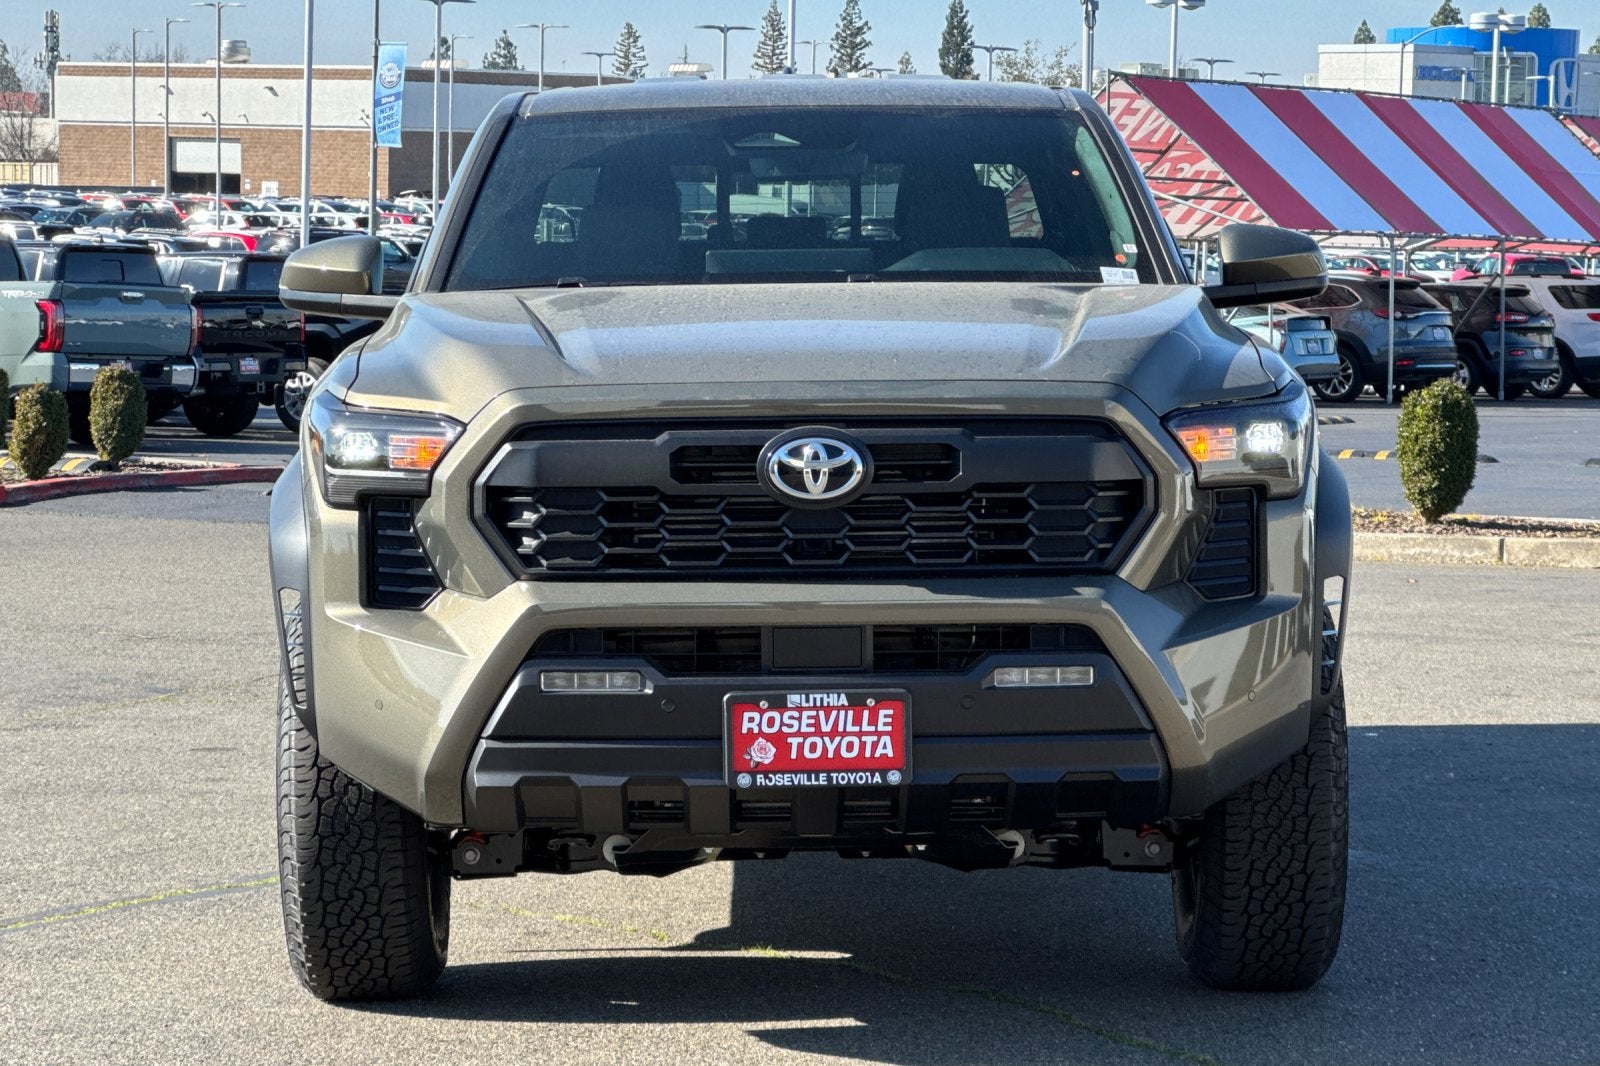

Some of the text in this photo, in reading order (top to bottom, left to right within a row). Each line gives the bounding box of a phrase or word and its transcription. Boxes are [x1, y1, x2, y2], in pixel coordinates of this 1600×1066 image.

[801, 693, 849, 708] LITHIA
[741, 709, 894, 734] ROSEVILLE
[787, 735, 894, 760] TOYOTA
[756, 772, 882, 786] ROSEVILLE TOYOTA
